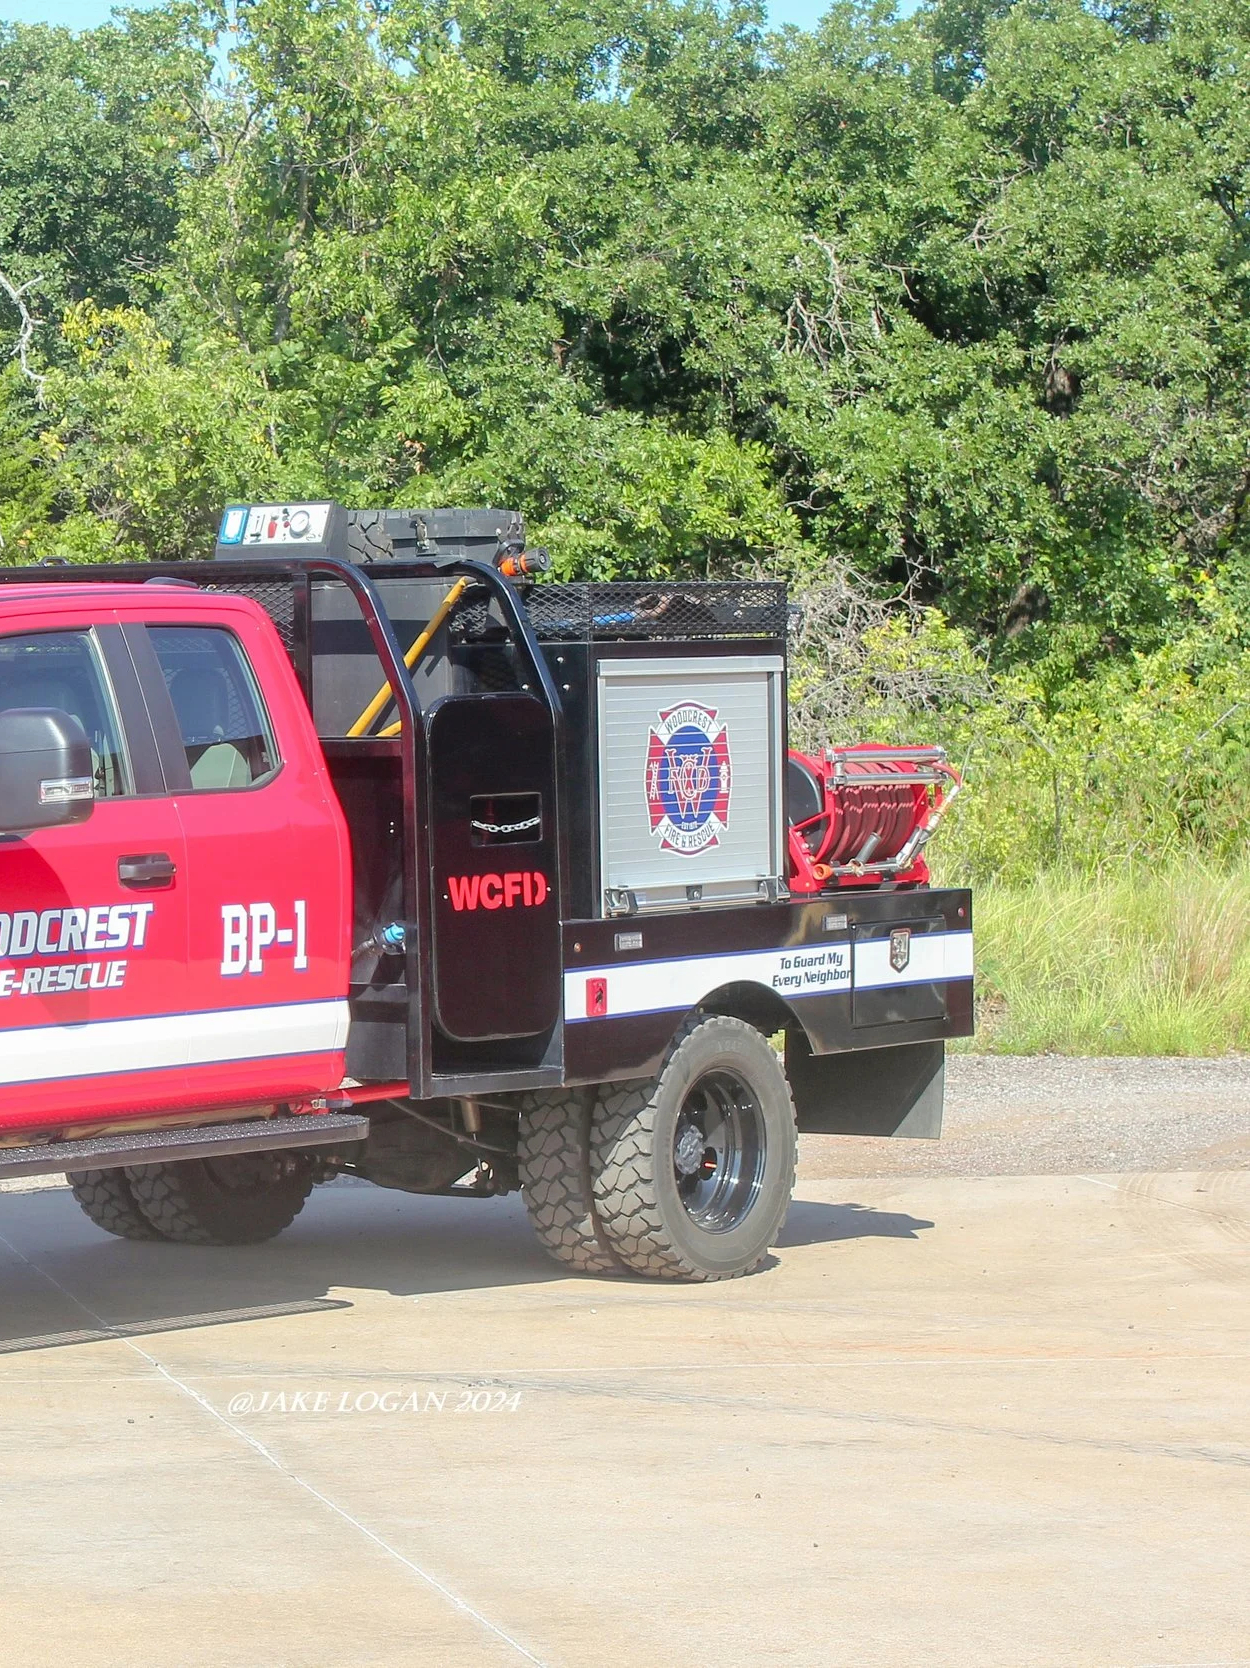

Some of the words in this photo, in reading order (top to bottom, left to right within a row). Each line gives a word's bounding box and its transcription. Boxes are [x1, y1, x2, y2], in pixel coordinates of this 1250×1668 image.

[448, 871, 548, 911] WCFD
[221, 900, 309, 977] BP-1
[780, 957, 792, 970] To
[793, 953, 825, 968] Guard
[827, 952, 843, 967] My
[772, 975, 802, 988] Every
[804, 968, 854, 984] Neighbor
